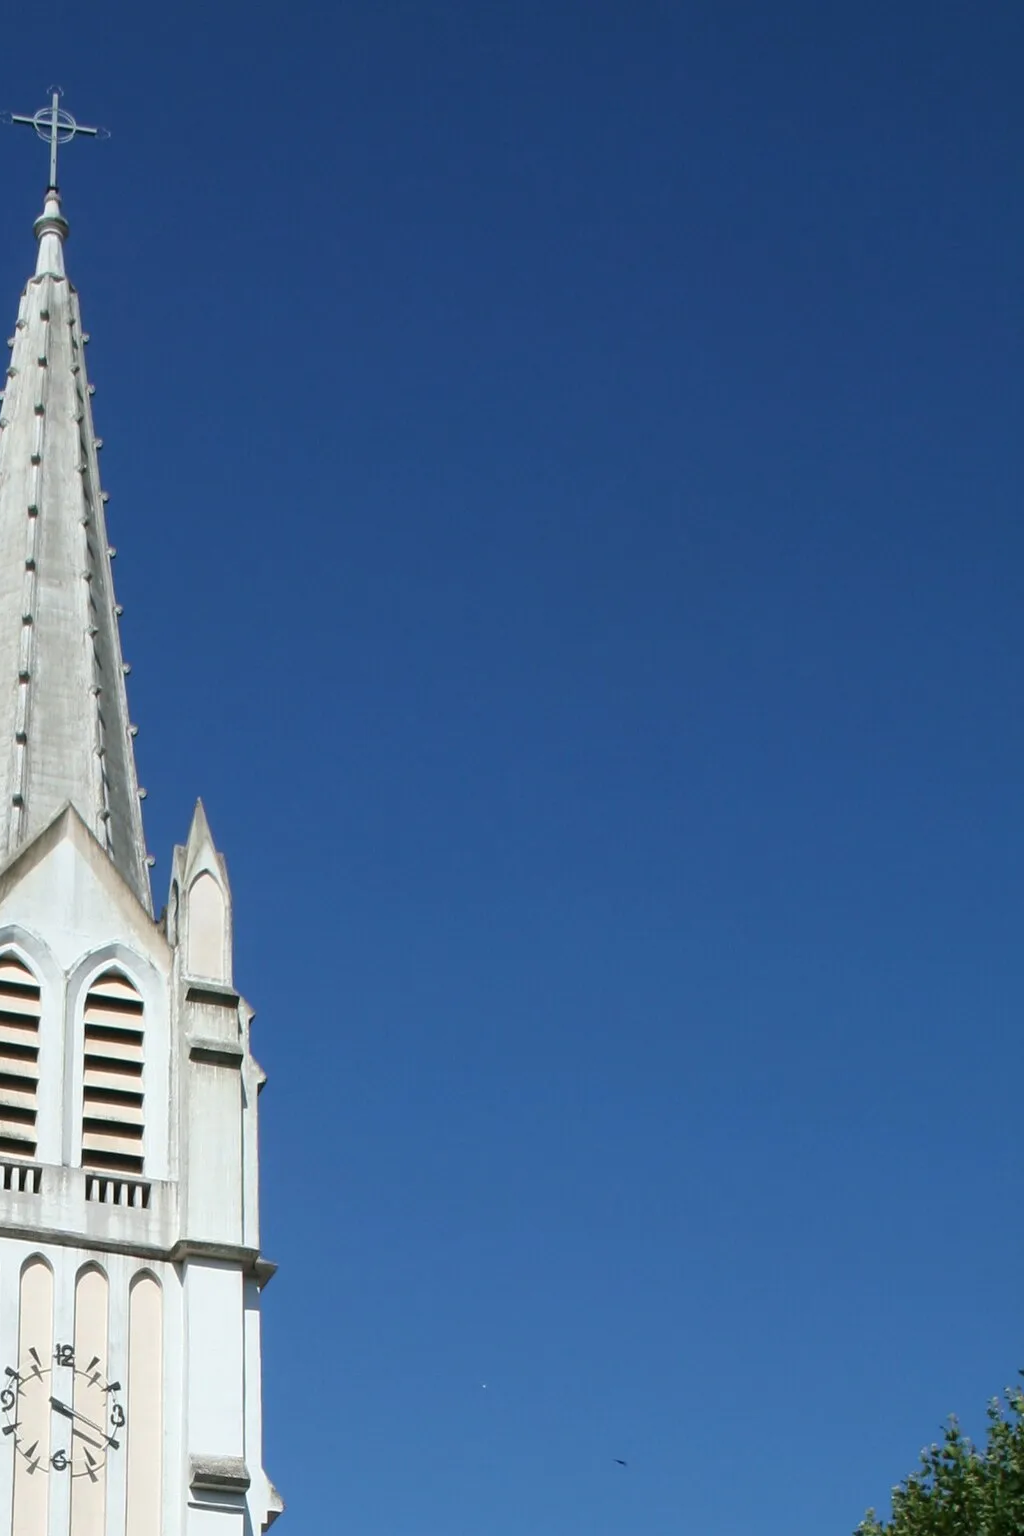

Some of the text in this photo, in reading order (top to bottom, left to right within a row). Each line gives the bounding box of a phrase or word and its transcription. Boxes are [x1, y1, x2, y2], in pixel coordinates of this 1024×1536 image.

[55, 1343, 74, 1367] 12
[0, 1389, 15, 1412] 9
[110, 1404, 126, 1428] 3
[52, 1449, 67, 1471] 6
